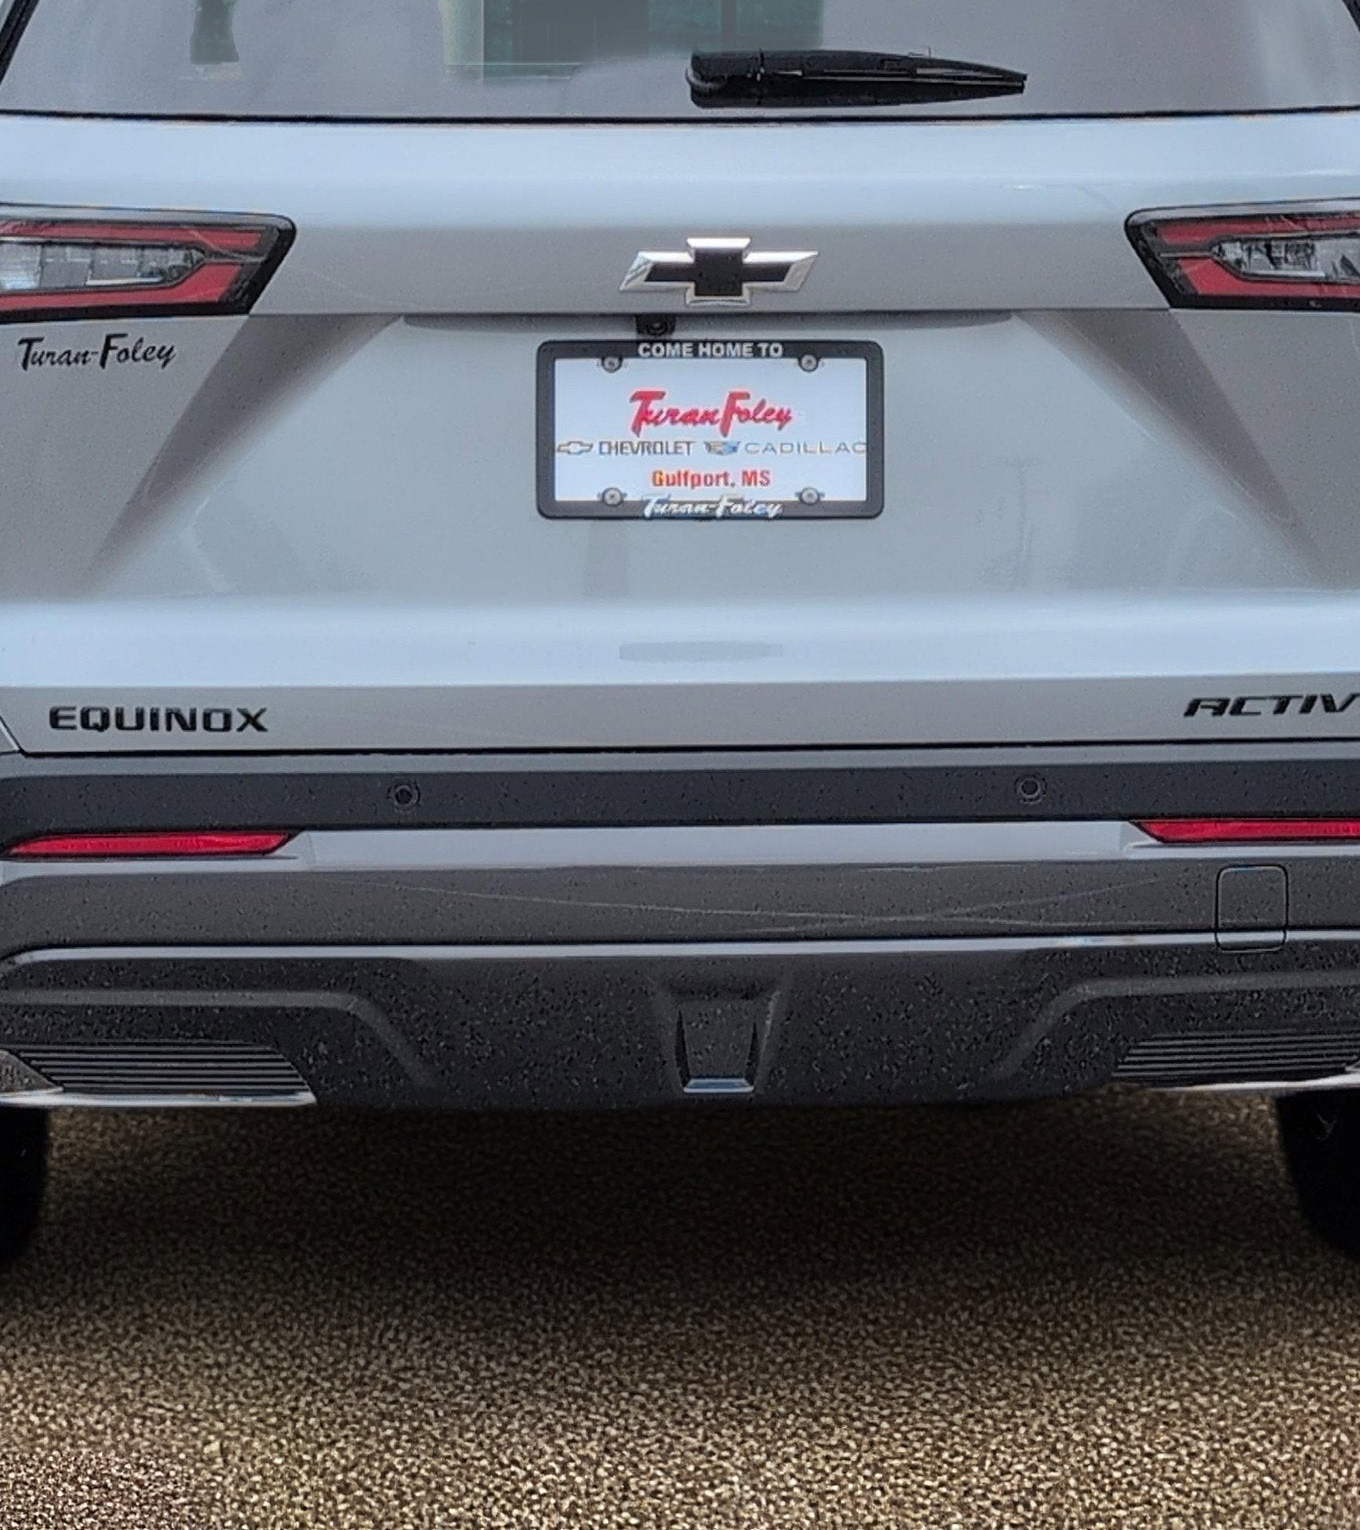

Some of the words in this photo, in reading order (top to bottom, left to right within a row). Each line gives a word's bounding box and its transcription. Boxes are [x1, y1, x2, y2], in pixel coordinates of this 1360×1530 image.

[638, 343, 693, 358] COME
[698, 343, 754, 358] HOME
[758, 343, 783, 358] TO
[598, 441, 695, 456] CHEVROLET
[745, 441, 867, 455] CADILLAC
[741, 470, 771, 487] MS
[49, 705, 268, 733] EQUINOX
